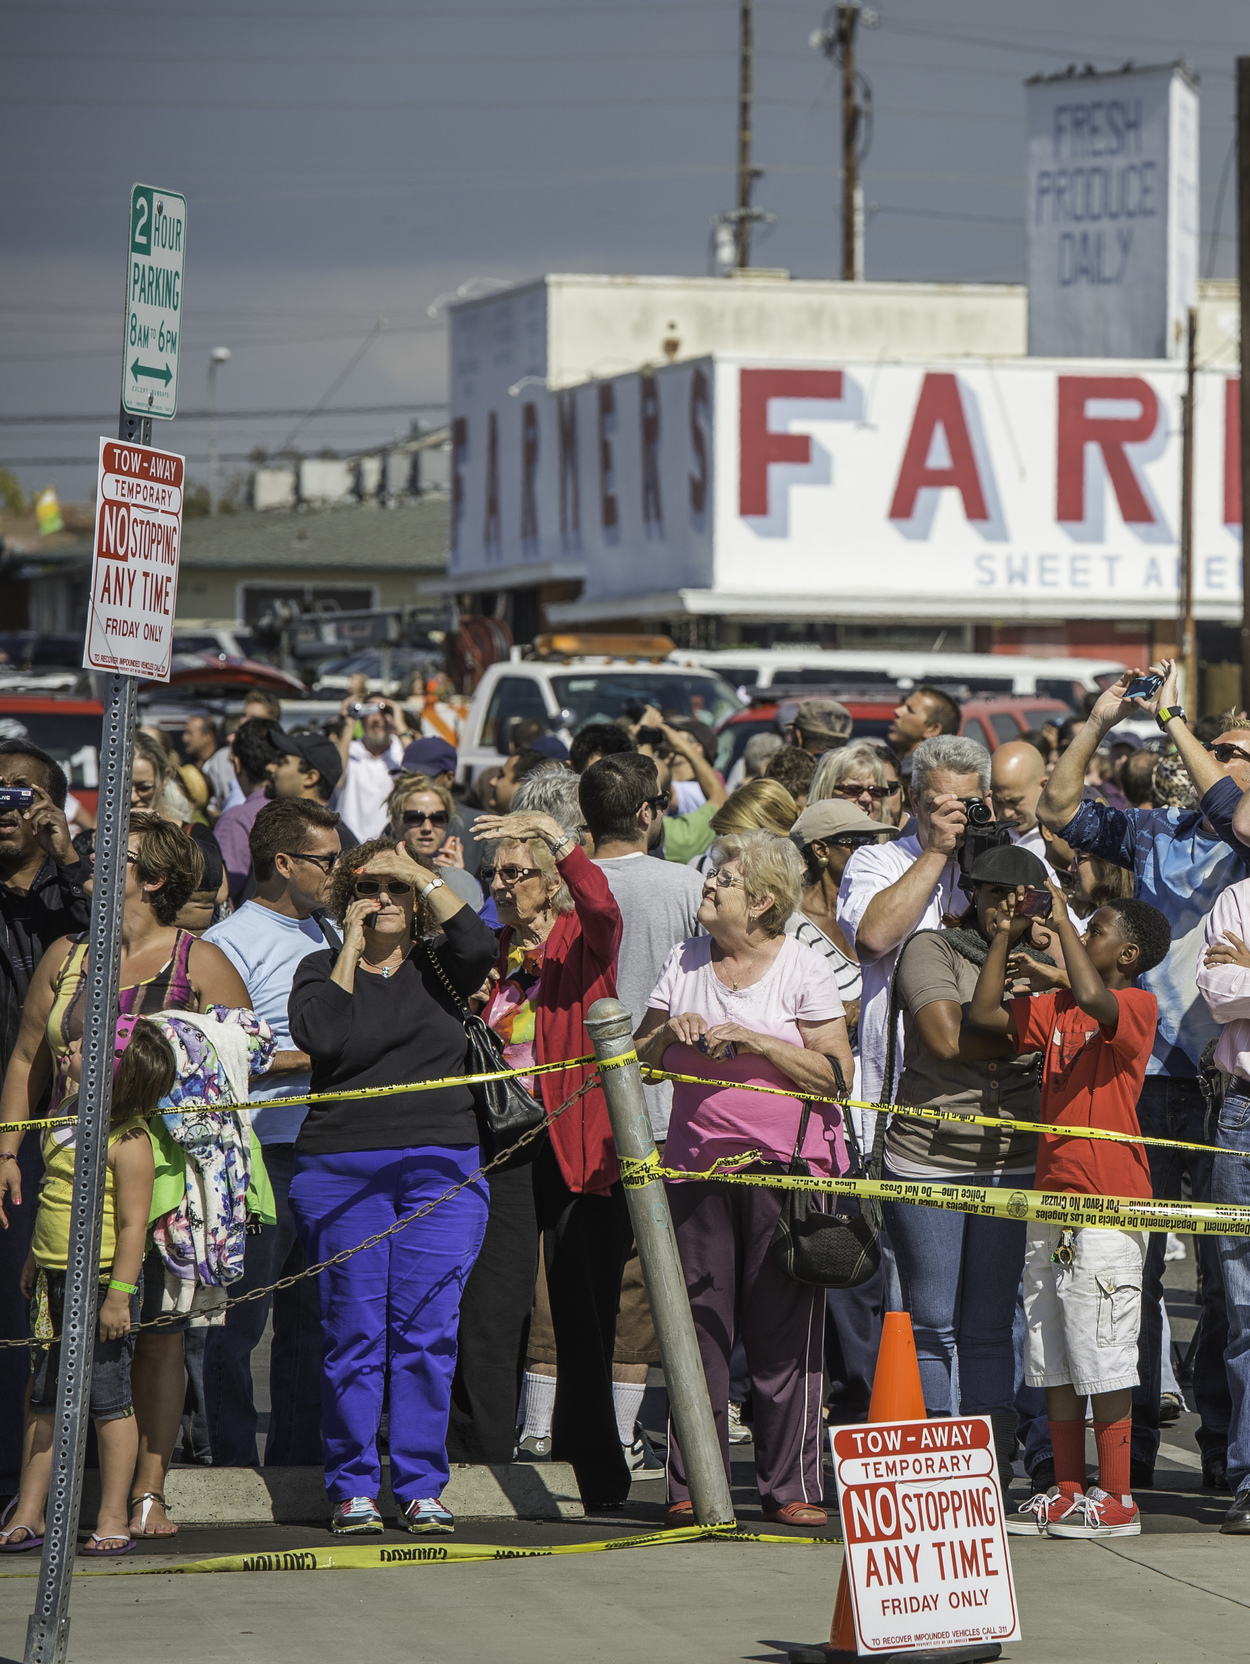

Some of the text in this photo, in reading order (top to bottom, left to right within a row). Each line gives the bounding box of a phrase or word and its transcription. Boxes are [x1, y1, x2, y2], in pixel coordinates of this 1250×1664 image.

[1053, 100, 1143, 159] FRESH
[1036, 161, 1156, 227] PRODUCE
[135, 196, 182, 252] 2 HOUR
[1058, 228, 1133, 286] DAILY
[132, 262, 180, 311] PARKING
[130, 312, 149, 349] 8AM
[158, 320, 177, 354] 6PM
[113, 448, 177, 481] TOW-AWAY
[451, 365, 709, 552] FARMERS
[115, 479, 173, 507] TEMPORARY
[102, 504, 177, 566] NO STOPPING
[976, 554, 1123, 588] SWEET
[100, 565, 172, 615] ANY TIME
[105, 618, 163, 642] FRIDAY ONLY
[879, 1183, 903, 1194] Cross
[904, 1185, 919, 1196] Not
[961, 1189, 986, 1203] Police
[1041, 1195, 1067, 1209] Cruzar
[1069, 1196, 1081, 1209] No
[946, 1202, 979, 1214] Angeles
[981, 1205, 996, 1216] Los
[1082, 1197, 1104, 1212] Favor
[1035, 1209, 1197, 1231] Departamento De Policia De Los Angeles
[1203, 1222, 1250, 1235] Department
[852, 1424, 973, 1454] TOW-AWAY
[861, 1454, 972, 1479] TEMPORARY
[850, 1487, 996, 1538] NO STOPPING
[866, 1538, 999, 1588] ANY TIME
[881, 1589, 989, 1617] FRIDAY ONLY
[871, 1625, 1008, 1646] TO RECOVER IMPOUNDED VEHICLES CALL 311
